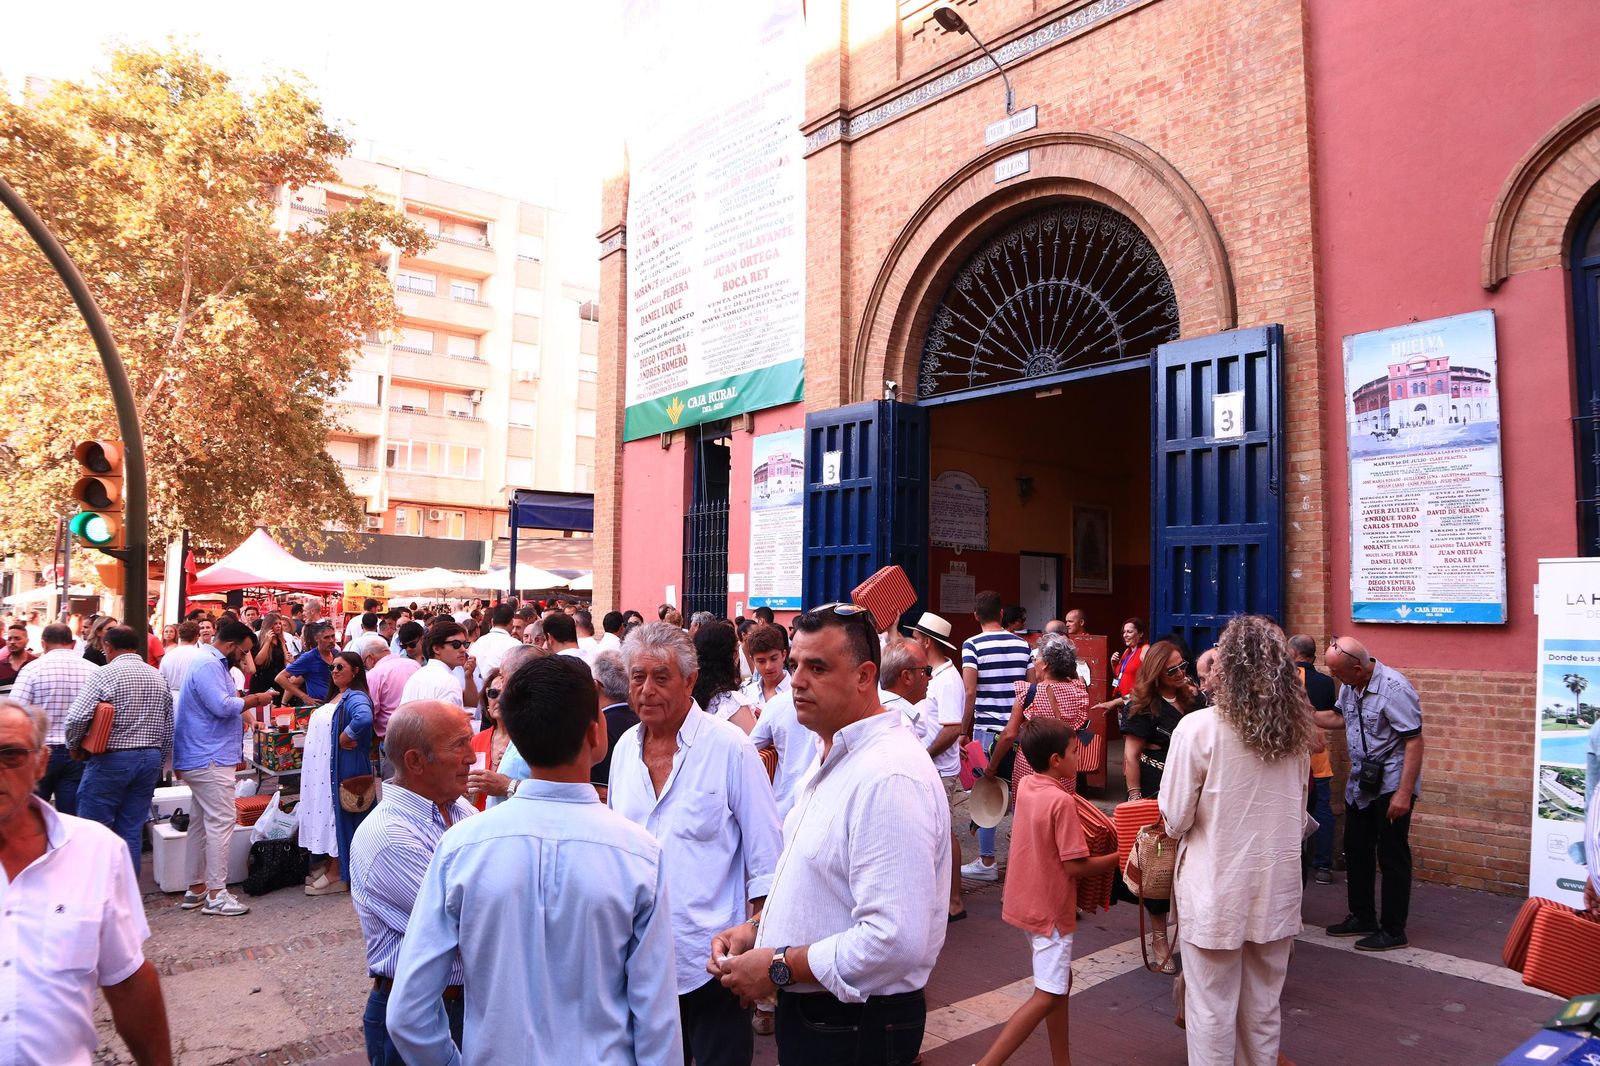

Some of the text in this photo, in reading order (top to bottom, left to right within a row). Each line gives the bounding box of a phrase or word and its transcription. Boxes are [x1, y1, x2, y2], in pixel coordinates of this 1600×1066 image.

[738, 225, 794, 253] TALAVANTE
[713, 248, 780, 280] JUAN ORTEGA
[722, 266, 770, 293] ROCA REY
[662, 280, 689, 300] PERERA
[707, 297, 731, 309] VENTA
[732, 286, 762, 299] ONLINE
[733, 300, 743, 308] DE
[745, 292, 770, 304] JUNIO
[640, 308, 660, 326] DANIEL
[661, 299, 683, 316] LUQUE
[633, 327, 656, 343] DOMINGO
[669, 311, 695, 325] AGOSTO
[640, 342, 687, 370] DIEGO VENTURA
[662, 355, 689, 374] ROMERO
[687, 394, 707, 409] CAJA
[708, 386, 738, 403] RURAL
[1221, 409, 1235, 432] 3
[827, 464, 836, 481] 3
[1361, 506, 1420, 516] JAVIER ZULUETA
[1364, 515, 1396, 523] ENRIQUE
[1458, 506, 1490, 514] MIRANDA
[1391, 521, 1419, 529] TIRADO
[1455, 540, 1492, 548] TALAVANTE
[1566, 593, 1587, 606] LA
[1431, 606, 1455, 614] RURAL
[1548, 653, 1578, 662] Donde
[1579, 654, 1595, 662] tus
